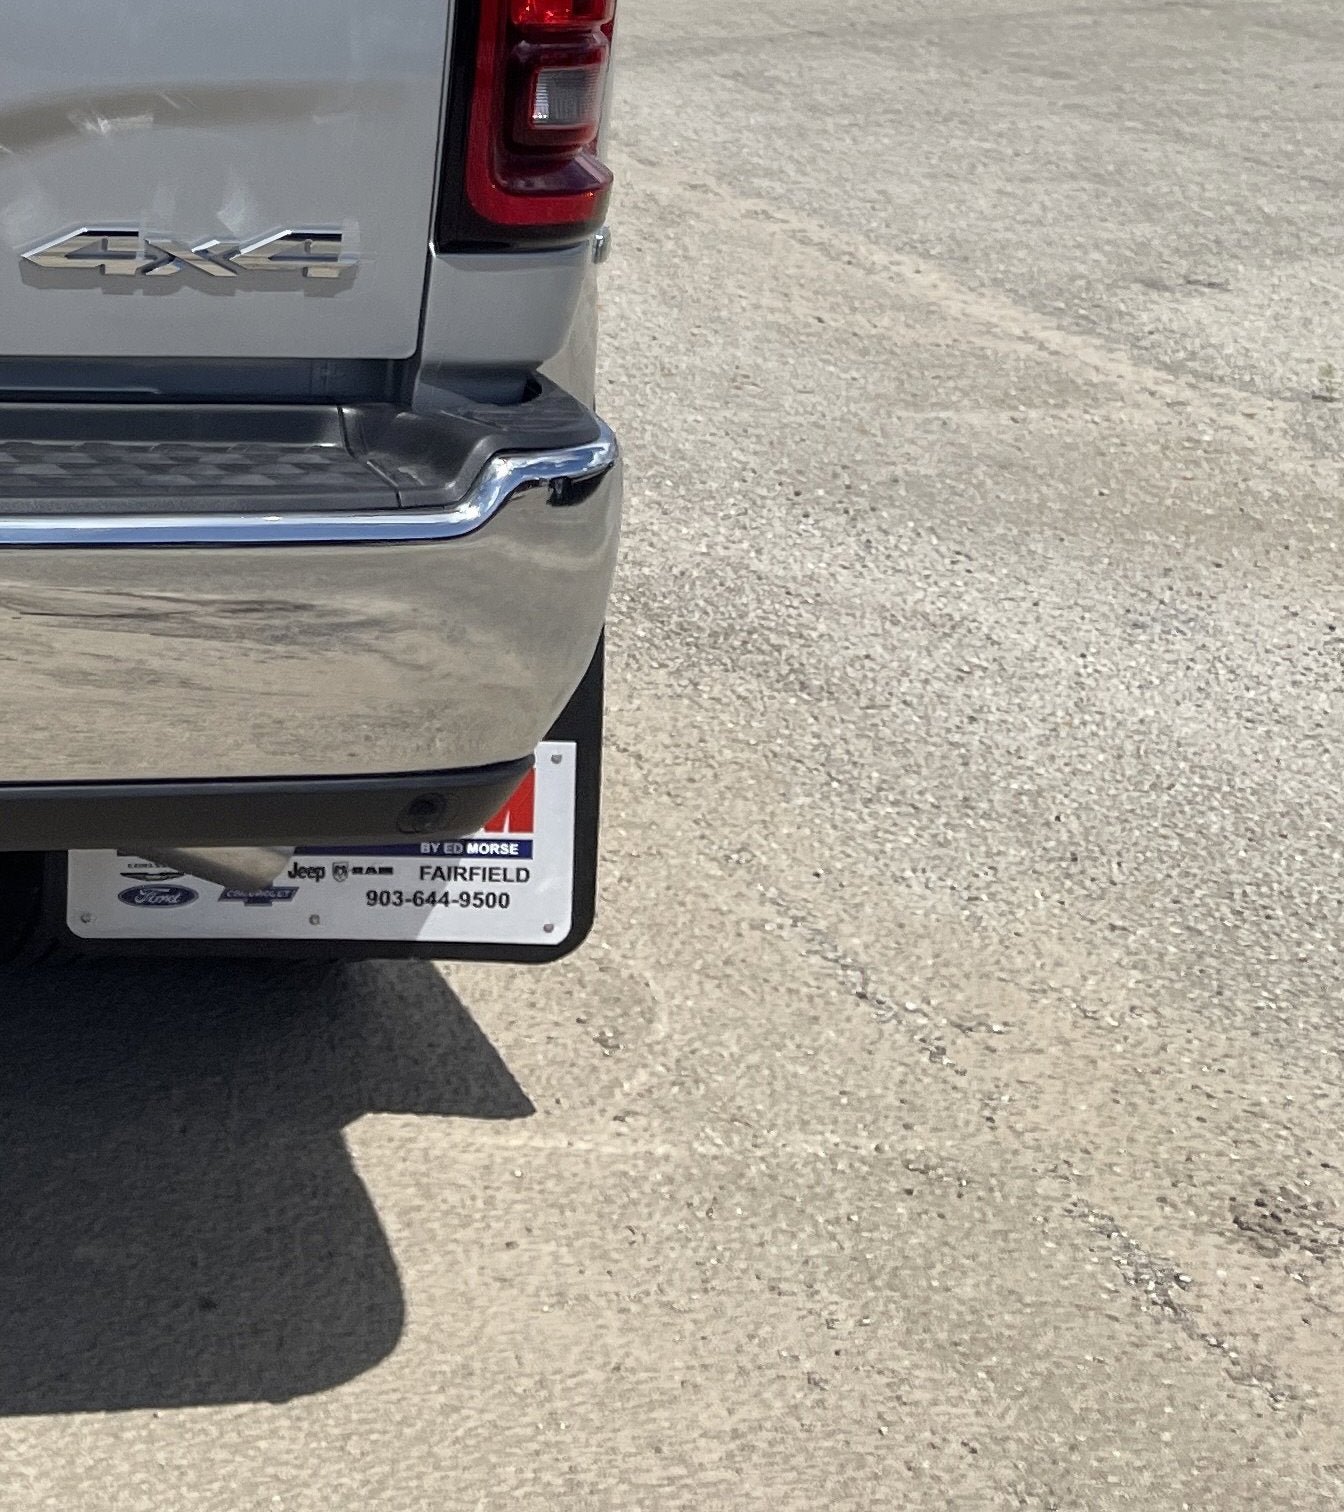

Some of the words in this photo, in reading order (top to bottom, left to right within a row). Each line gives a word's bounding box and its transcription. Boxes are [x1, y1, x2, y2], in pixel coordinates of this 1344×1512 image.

[420, 842, 441, 855] BY
[443, 842, 463, 855] ED
[466, 842, 520, 855] MORSE
[288, 862, 325, 881] Jeep
[419, 865, 531, 884] FAIRFIELD
[366, 890, 511, 910] 903-644-9500
